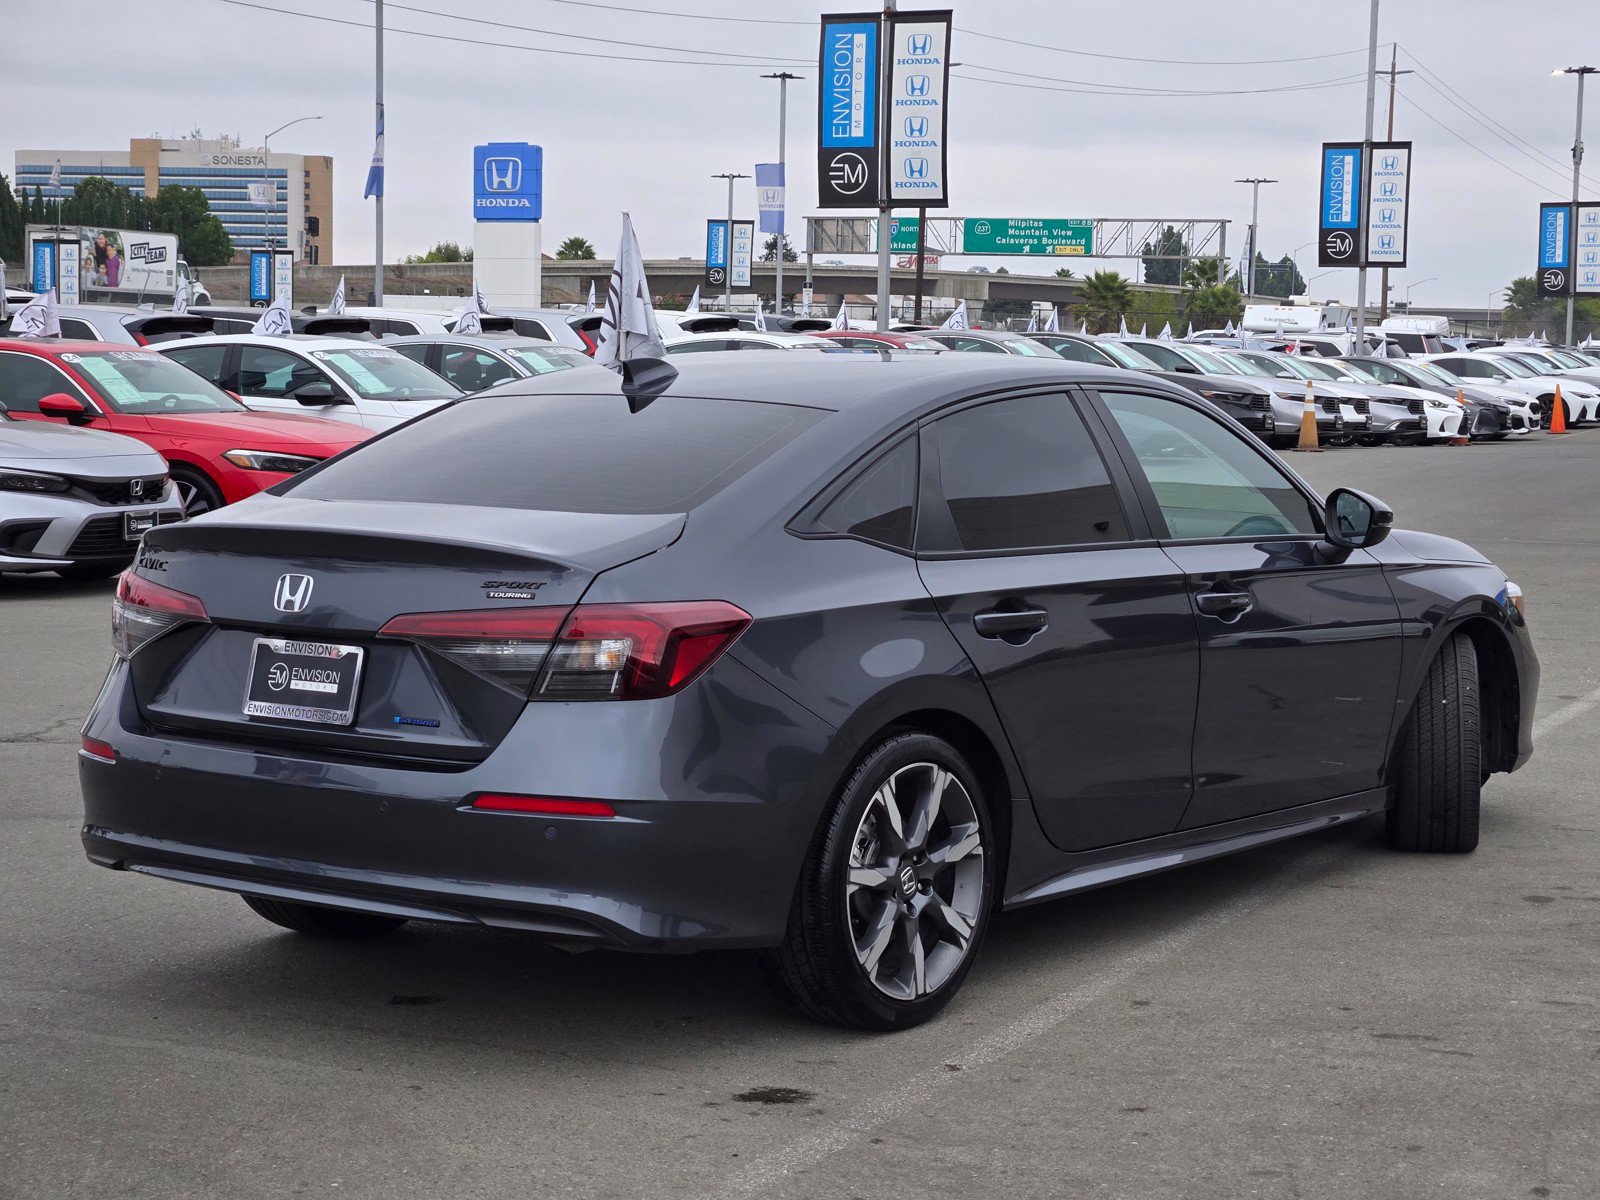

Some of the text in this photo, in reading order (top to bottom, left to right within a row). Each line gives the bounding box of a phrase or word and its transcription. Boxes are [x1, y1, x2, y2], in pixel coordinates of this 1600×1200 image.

[896, 57, 941, 65] HONDA
[832, 33, 852, 138] ENVISION
[854, 42, 864, 129] MOTORS
[212, 155, 266, 166] SONESTA
[894, 181, 939, 189] HONDA
[1328, 154, 1344, 222] ENVISION
[1343, 161, 1352, 217] MOTORS
[476, 198, 532, 207] HONDA
[1008, 219, 1044, 228] Milpitas
[1008, 228, 1073, 236] Mountain View
[1545, 211, 1557, 264] ENVISION
[995, 236, 1086, 245] Calaveras Boulevard
[133, 245, 147, 256] CITY
[147, 250, 165, 261] TEAM
[254, 256, 262, 296] ENVISION
[480, 581, 548, 590] SPORT
[284, 642, 333, 656] ENVISION
[291, 667, 341, 683] ENVISION
[294, 682, 334, 691] MOTORS
[247, 703, 348, 722] ENVISIONMOTORS.COM
